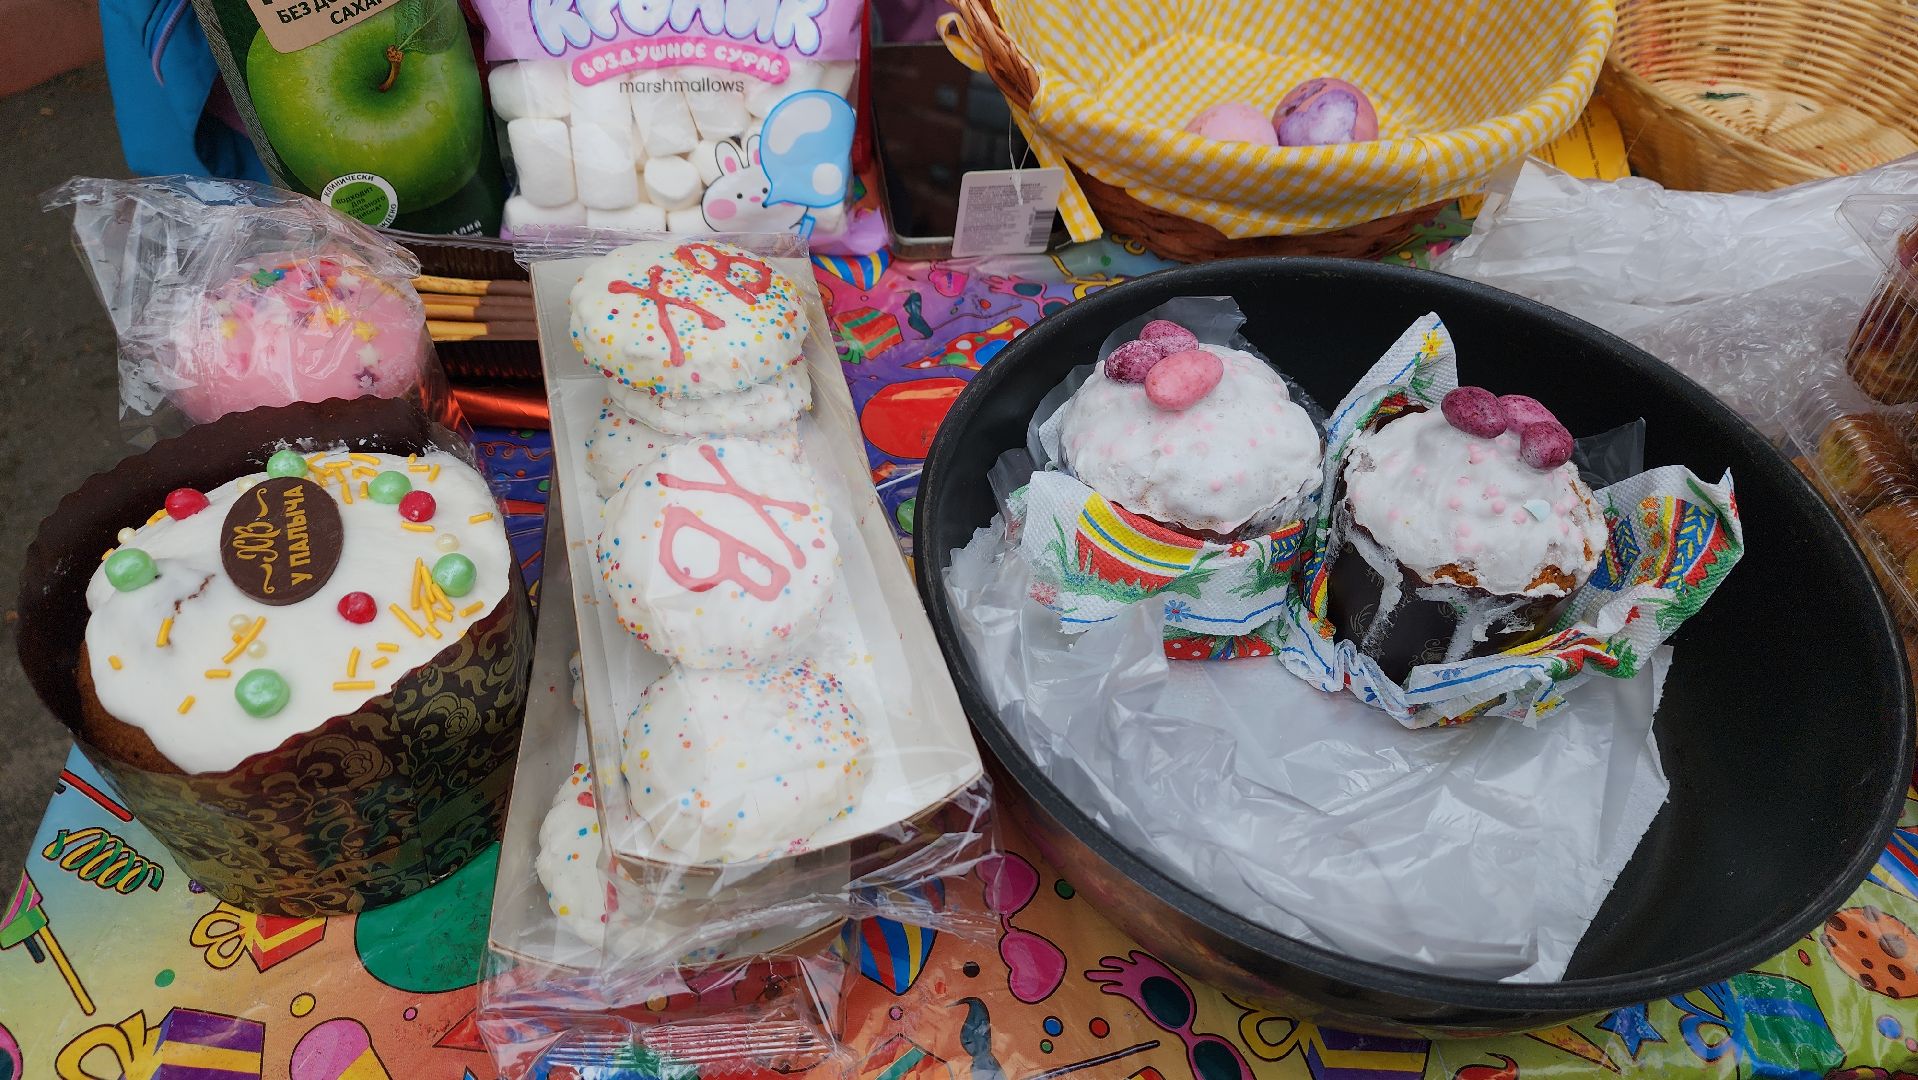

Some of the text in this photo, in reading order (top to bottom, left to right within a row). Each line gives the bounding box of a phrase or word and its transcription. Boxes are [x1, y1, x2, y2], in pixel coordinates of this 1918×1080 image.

[276, 1, 312, 24] БЕЗ
[330, 0, 383, 25] САХА
[579, 42, 784, 79] ВОЗДУШНОЕ СУФЛЕ
[619, 77, 745, 93] marshmallows
[324, 174, 375, 198] КЛИНИЧЕСКИ
[335, 187, 374, 205] ПОДХОДИТ
[346, 195, 386, 215] ЕДНЕВНОГО
[351, 198, 366, 209] ДЛЯ
[283, 484, 313, 586] У ПАЛЫЧА
